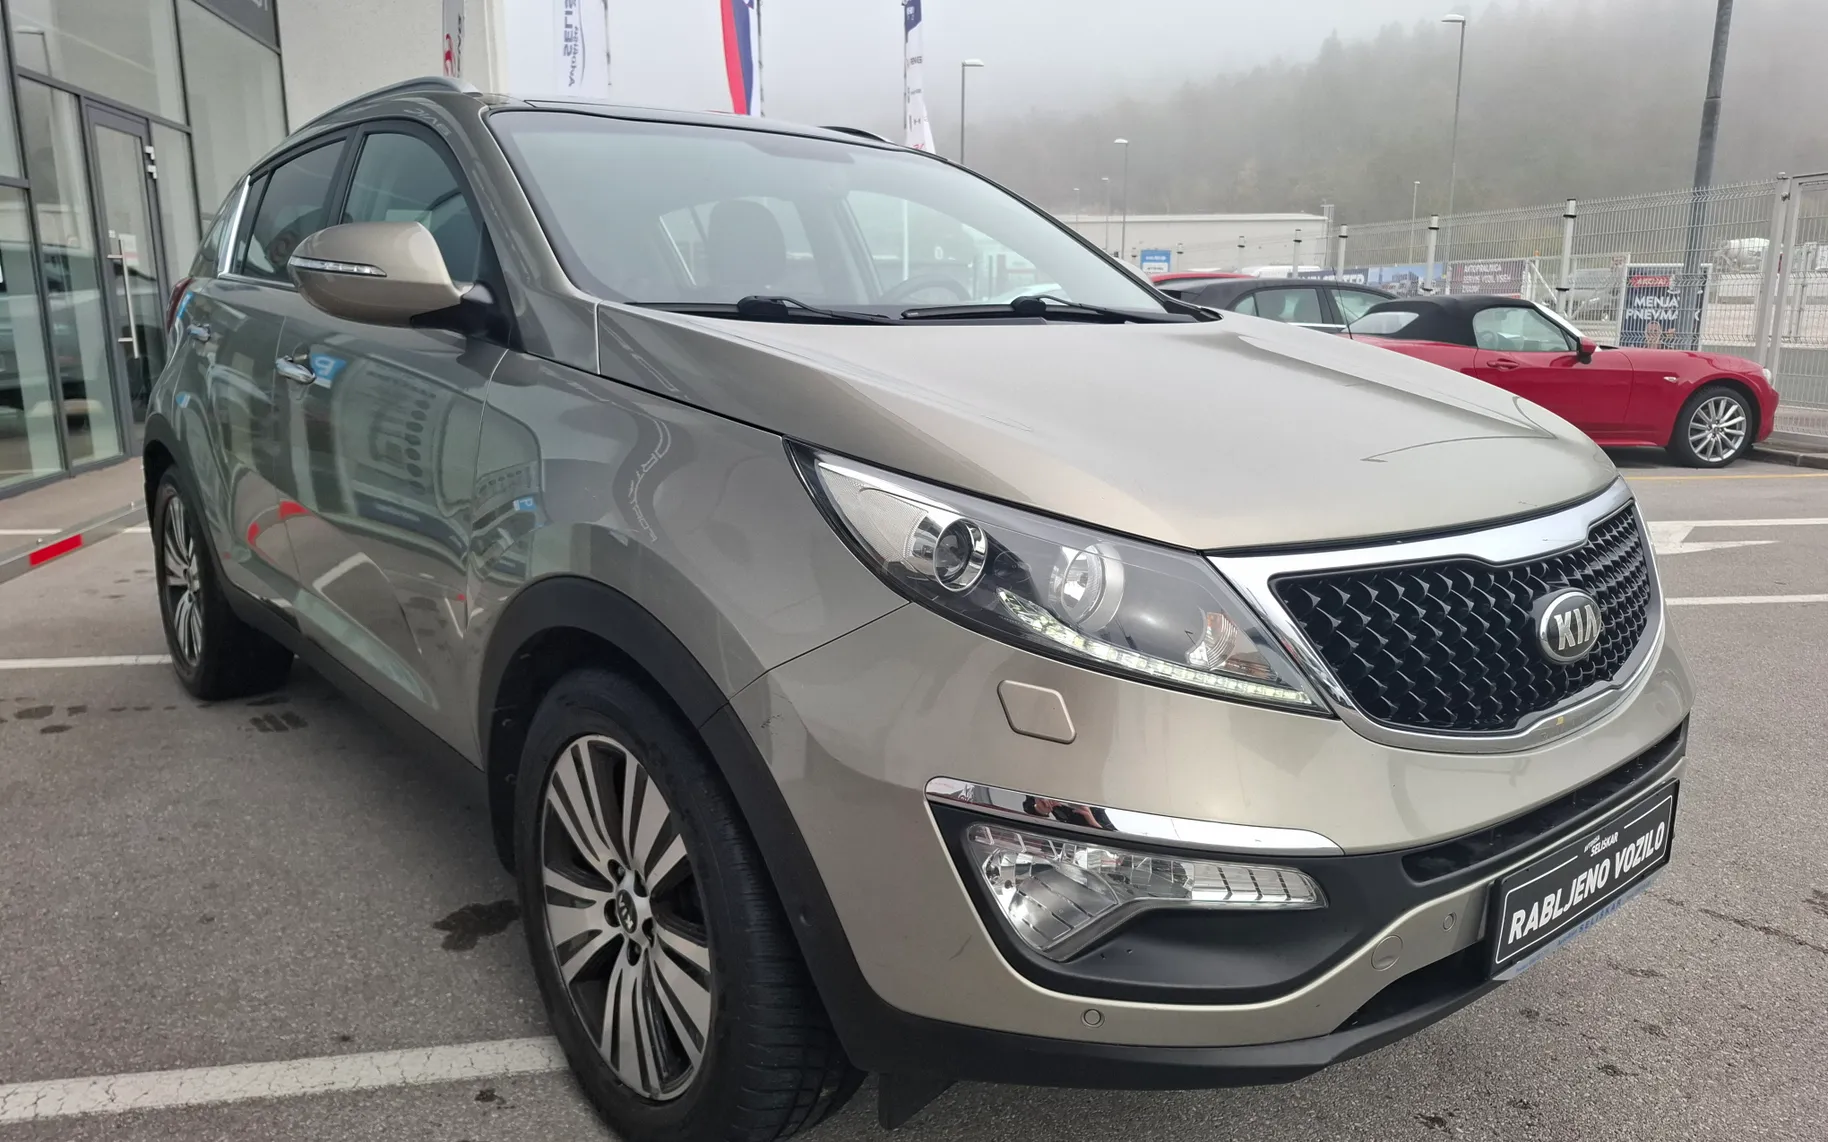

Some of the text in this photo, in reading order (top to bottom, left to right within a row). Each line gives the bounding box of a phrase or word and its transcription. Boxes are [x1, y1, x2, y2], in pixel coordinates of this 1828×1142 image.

[1553, 604, 1598, 651] KIA
[1508, 821, 1665, 944] RABLJENO VOZILO
